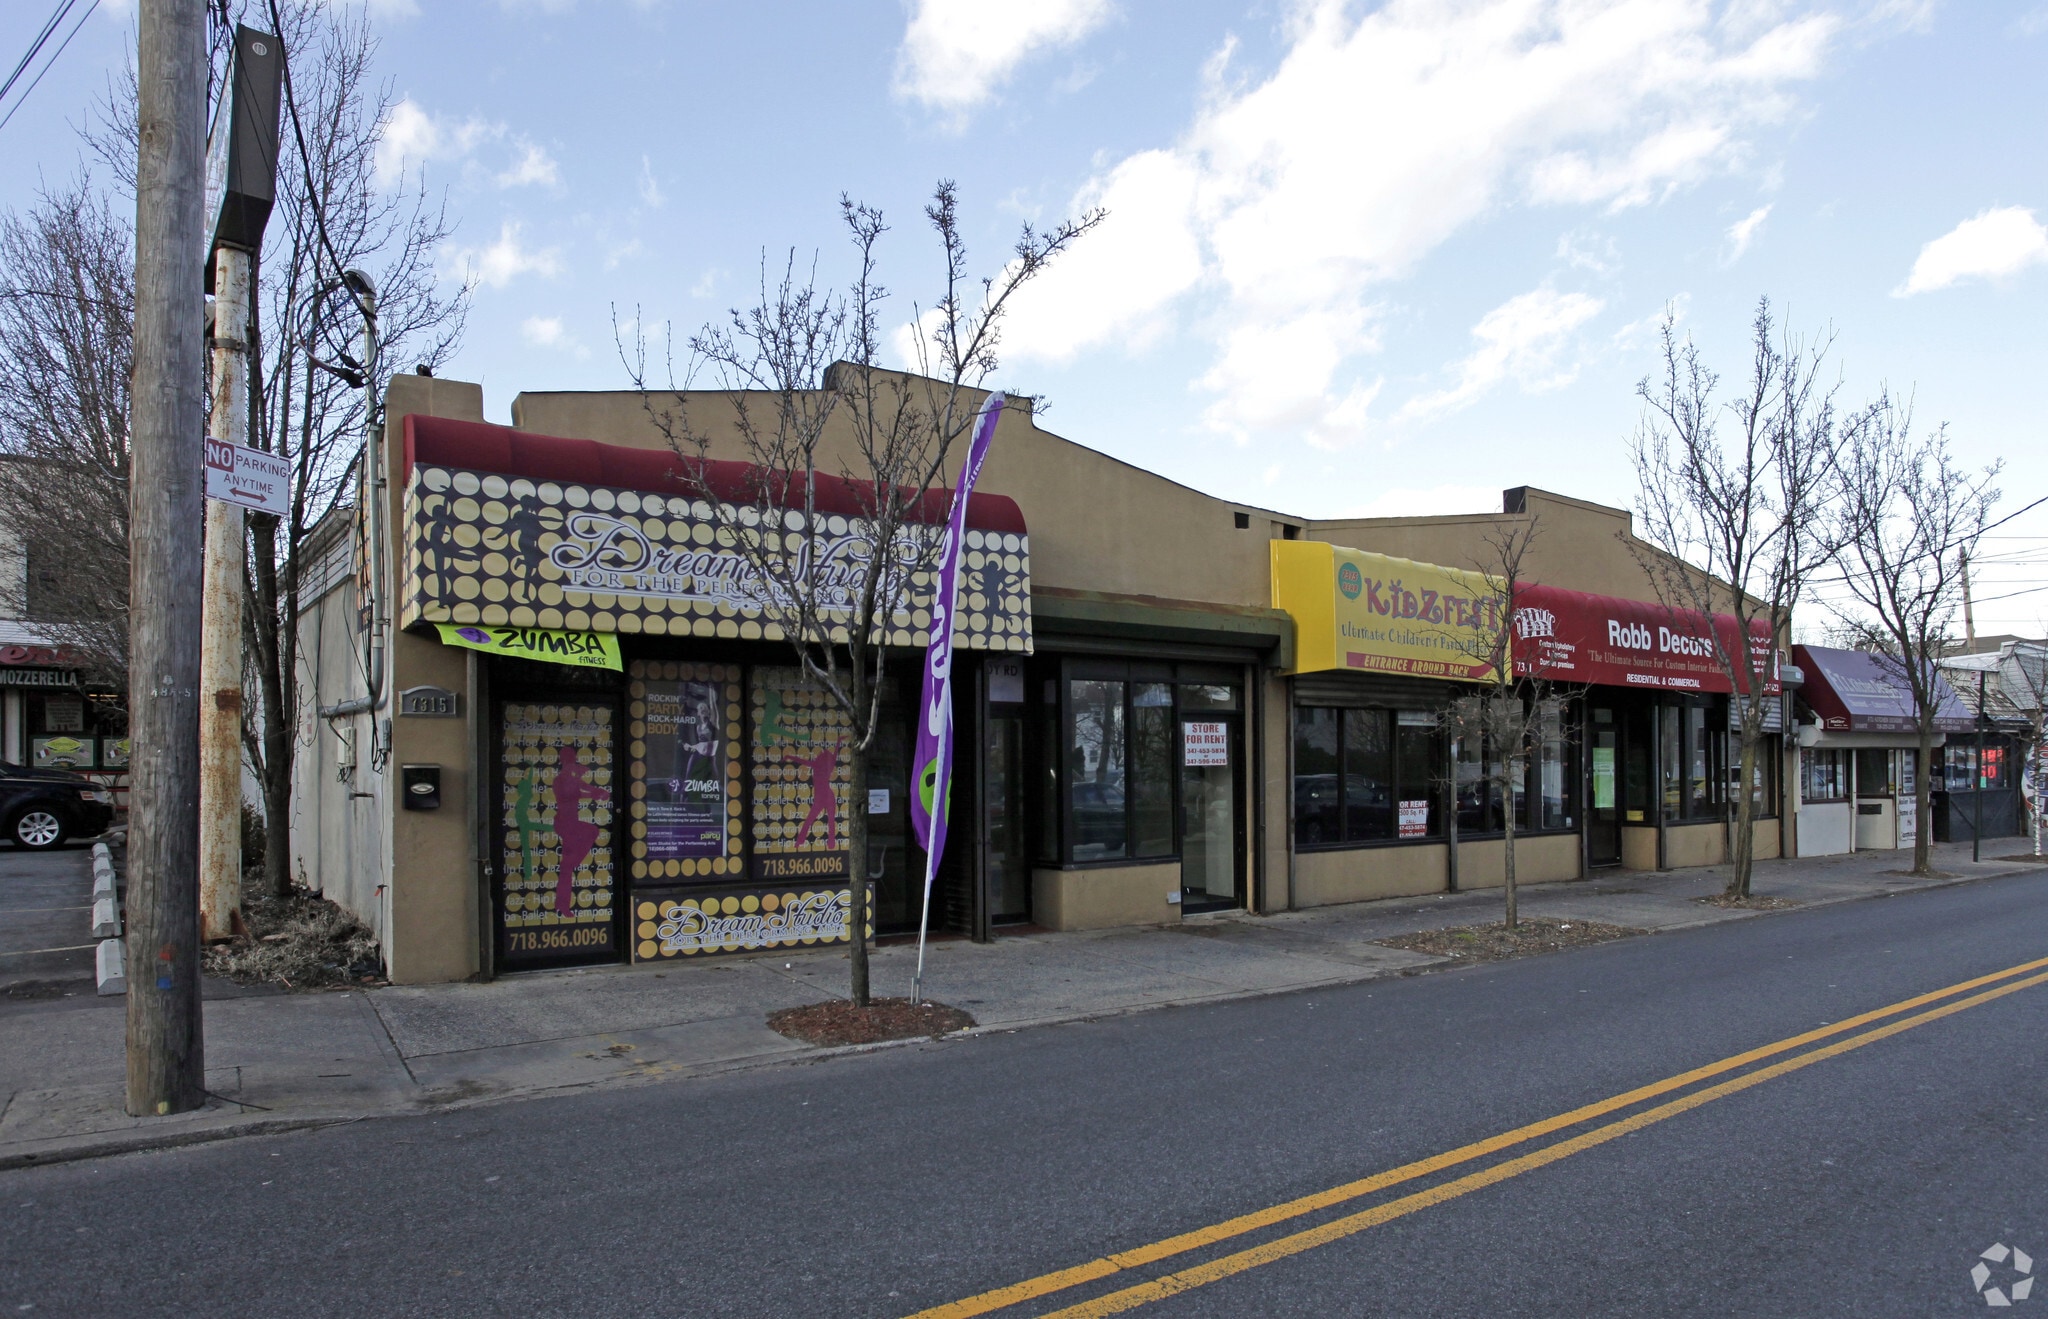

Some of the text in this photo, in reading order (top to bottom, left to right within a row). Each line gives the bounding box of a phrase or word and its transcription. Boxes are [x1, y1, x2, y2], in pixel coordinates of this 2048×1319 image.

[207, 443, 287, 478] NO PARKING
[223, 473, 275, 494] ANYTIME
[551, 513, 759, 580] Dream
[572, 570, 622, 587] FOR
[635, 574, 682, 591] THE
[493, 629, 607, 656] ZUMBA
[1341, 620, 1385, 642] Ultimate
[1388, 628, 1437, 649] Children's
[1607, 619, 1713, 658] Robb Decors
[578, 656, 606, 666] FITNESS
[1004, 665, 1018, 676] RD
[1364, 654, 1408, 672] ENTRANCE
[1411, 660, 1446, 675] AROUND
[1604, 652, 1632, 666] Ultimate
[1633, 656, 1652, 667] Source
[1654, 658, 1664, 668] For
[1665, 659, 1686, 671] Custom
[1687, 661, 1707, 672] Interior
[0, 669, 77, 686] MOZZERELLA
[1626, 673, 1700, 688] RESIDENTIAL & COMMERCIAL
[412, 697, 447, 713] 7315
[648, 694, 681, 703] ROCKIN'
[647, 703, 685, 716] PARTY.
[647, 714, 696, 725] ROCK-HARD
[647, 723, 679, 735] BODY.
[1192, 724, 1219, 733] STORE
[1186, 735, 1225, 744] FOR RENT
[684, 779, 720, 793] ZUMBA
[763, 857, 842, 876] 718.966.0096
[657, 889, 851, 940] Dream Studio
[509, 927, 608, 952] 718.966.0096
[668, 923, 847, 947] FOR THE PERFORMING ARTS
